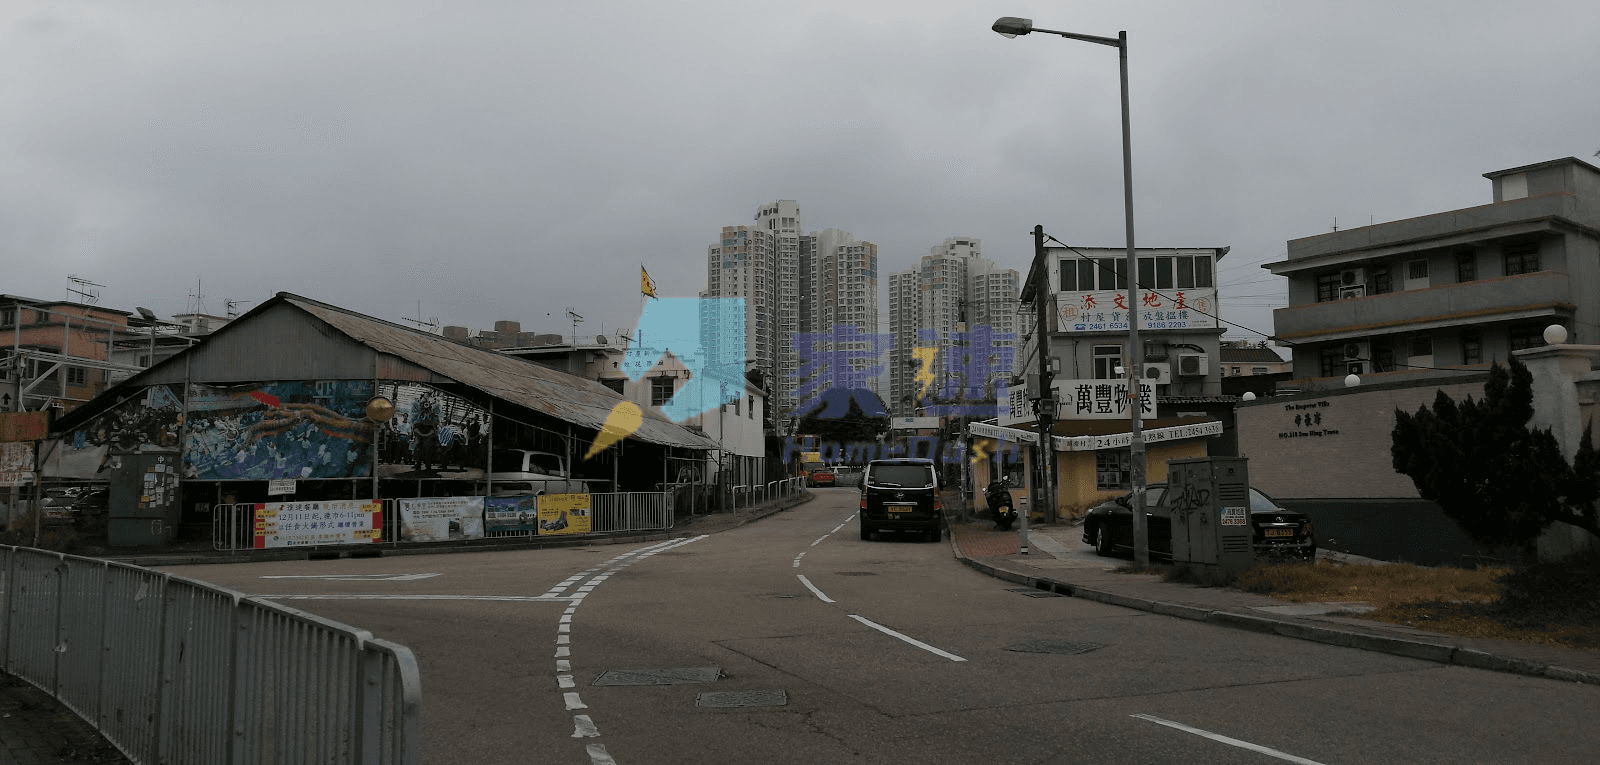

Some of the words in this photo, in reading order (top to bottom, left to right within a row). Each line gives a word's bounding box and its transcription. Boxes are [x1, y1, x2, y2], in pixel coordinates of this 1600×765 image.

[1080, 292, 1188, 310] 添文地產
[1169, 320, 1186, 328] 2293
